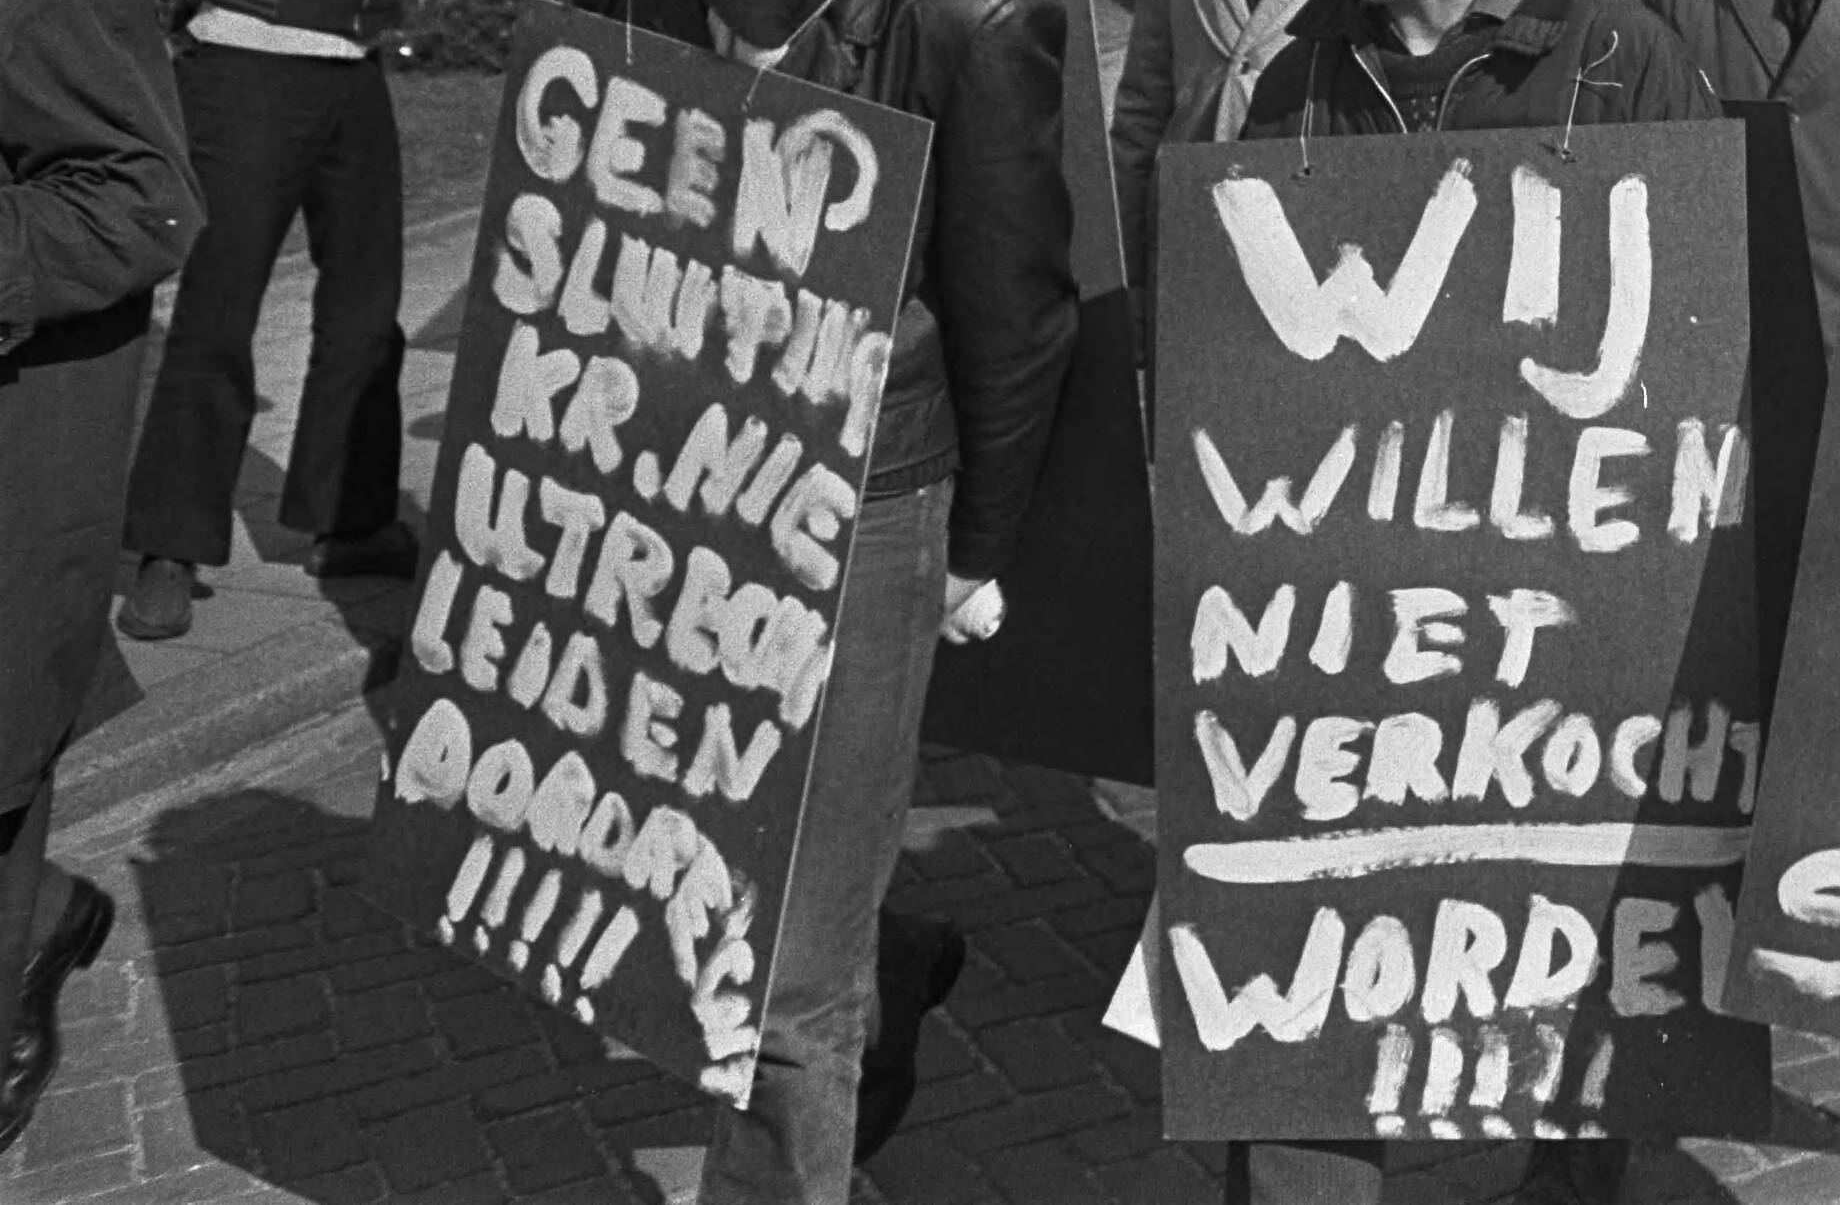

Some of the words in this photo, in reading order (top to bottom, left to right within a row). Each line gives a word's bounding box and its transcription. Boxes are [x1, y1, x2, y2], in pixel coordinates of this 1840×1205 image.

[1212, 157, 1652, 418] WIJ
[1192, 409, 1751, 552] WILLEN
[411, 550, 781, 802] LEIDEN
[1190, 581, 1580, 688] NIET
